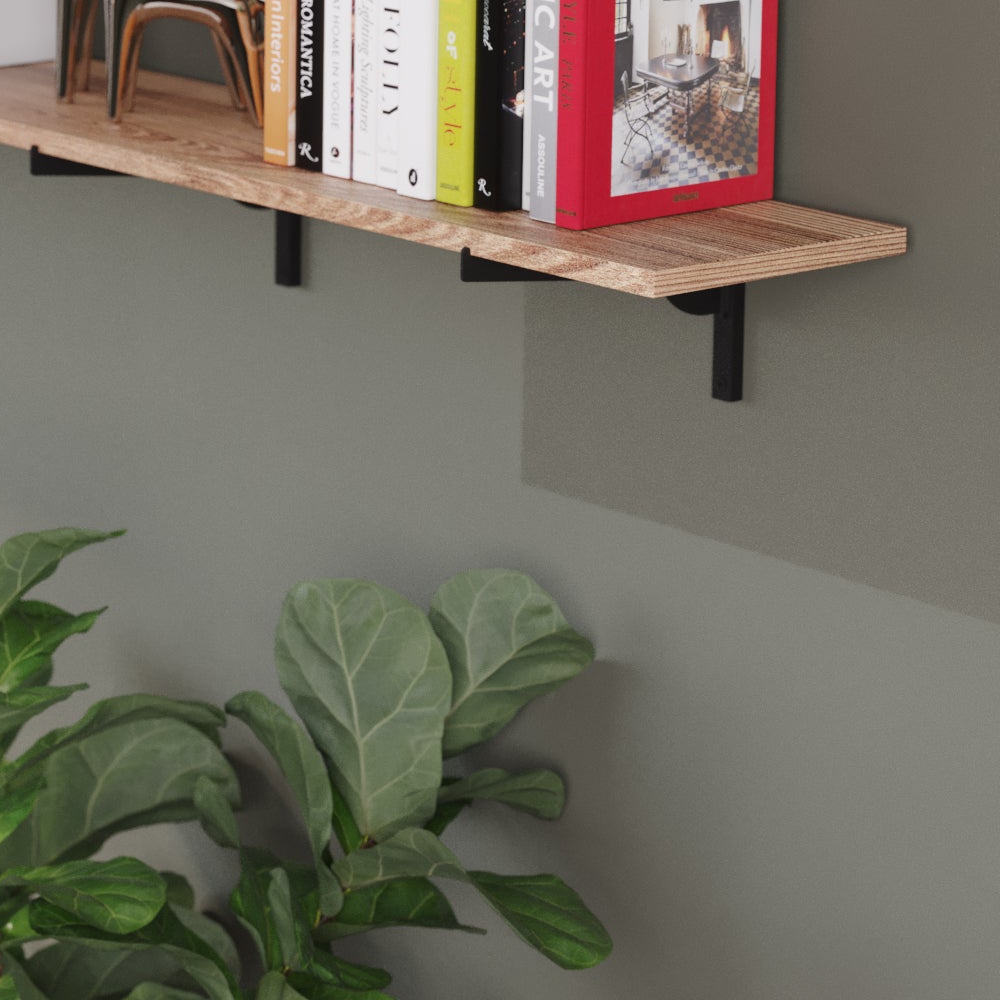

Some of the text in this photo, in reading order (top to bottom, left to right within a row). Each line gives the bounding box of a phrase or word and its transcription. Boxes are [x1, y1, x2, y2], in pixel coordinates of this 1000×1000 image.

[270, 13, 285, 93] Interiors
[331, 14, 342, 57] HOME
[447, 30, 459, 60] OF
[330, 60, 342, 77] IN
[534, 39, 557, 113] ART
[561, 57, 577, 112] PARIS
[331, 79, 342, 129] VOGUE
[358, 58, 375, 135] Sculptures
[537, 133, 547, 198] ASSOULINE
